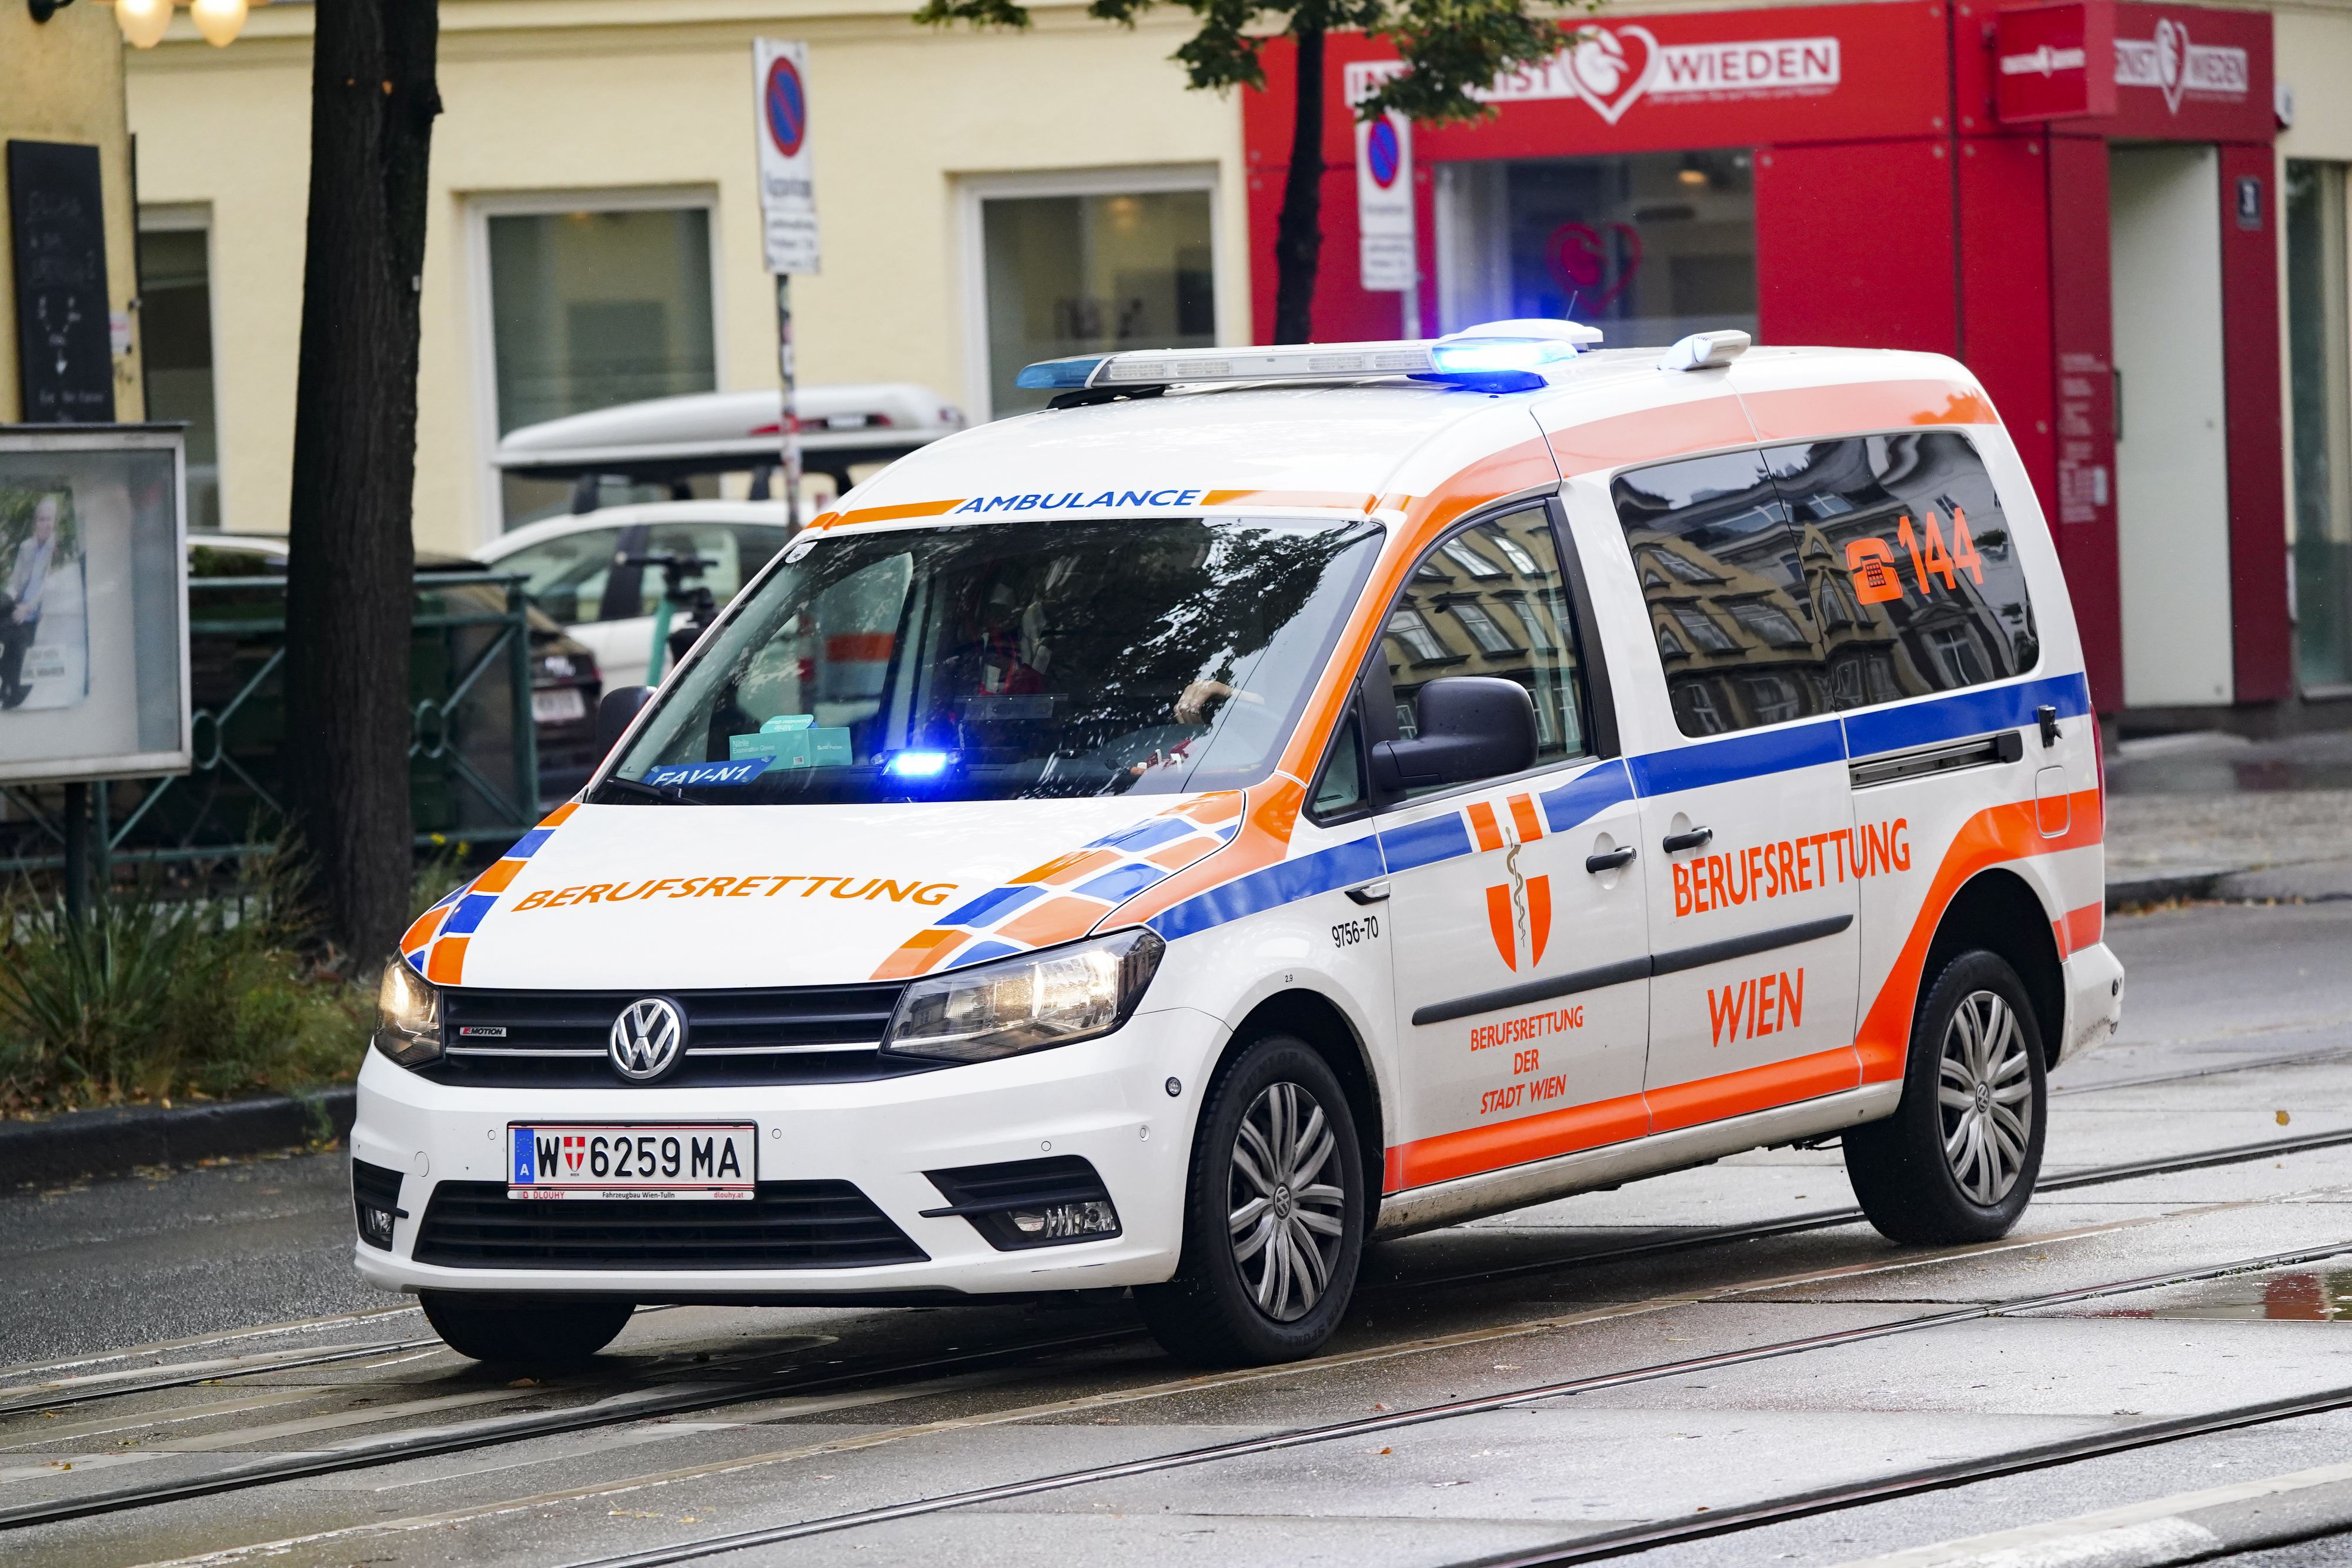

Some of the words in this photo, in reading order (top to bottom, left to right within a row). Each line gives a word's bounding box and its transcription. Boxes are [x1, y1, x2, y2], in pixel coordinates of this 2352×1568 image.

[1666, 46, 1830, 83] WIEDEN
[954, 489, 1202, 514] AMBULANCE
[1897, 507, 1984, 595] 144
[651, 765, 752, 787] FAV-N1
[1672, 818, 1911, 918] BERUFSRETTUNG
[510, 876, 959, 912] BERUFSRETTUNG
[1332, 915, 1379, 948] 9756-70
[1707, 968, 1805, 1048] WIEN
[1471, 1005, 1583, 1051] BERUFSRETTUNG
[1514, 1048, 1539, 1075] DER
[1481, 1082, 1525, 1115] STADT
[1530, 1074, 1567, 1103] WIEN
[520, 1164, 529, 1176] A
[536, 1136, 560, 1177] W
[590, 1136, 680, 1178] 6259
[691, 1136, 741, 1178] MA
[602, 1191, 641, 1200] Fahrzeugbau
[714, 1191, 744, 1199] dlouhy.at
